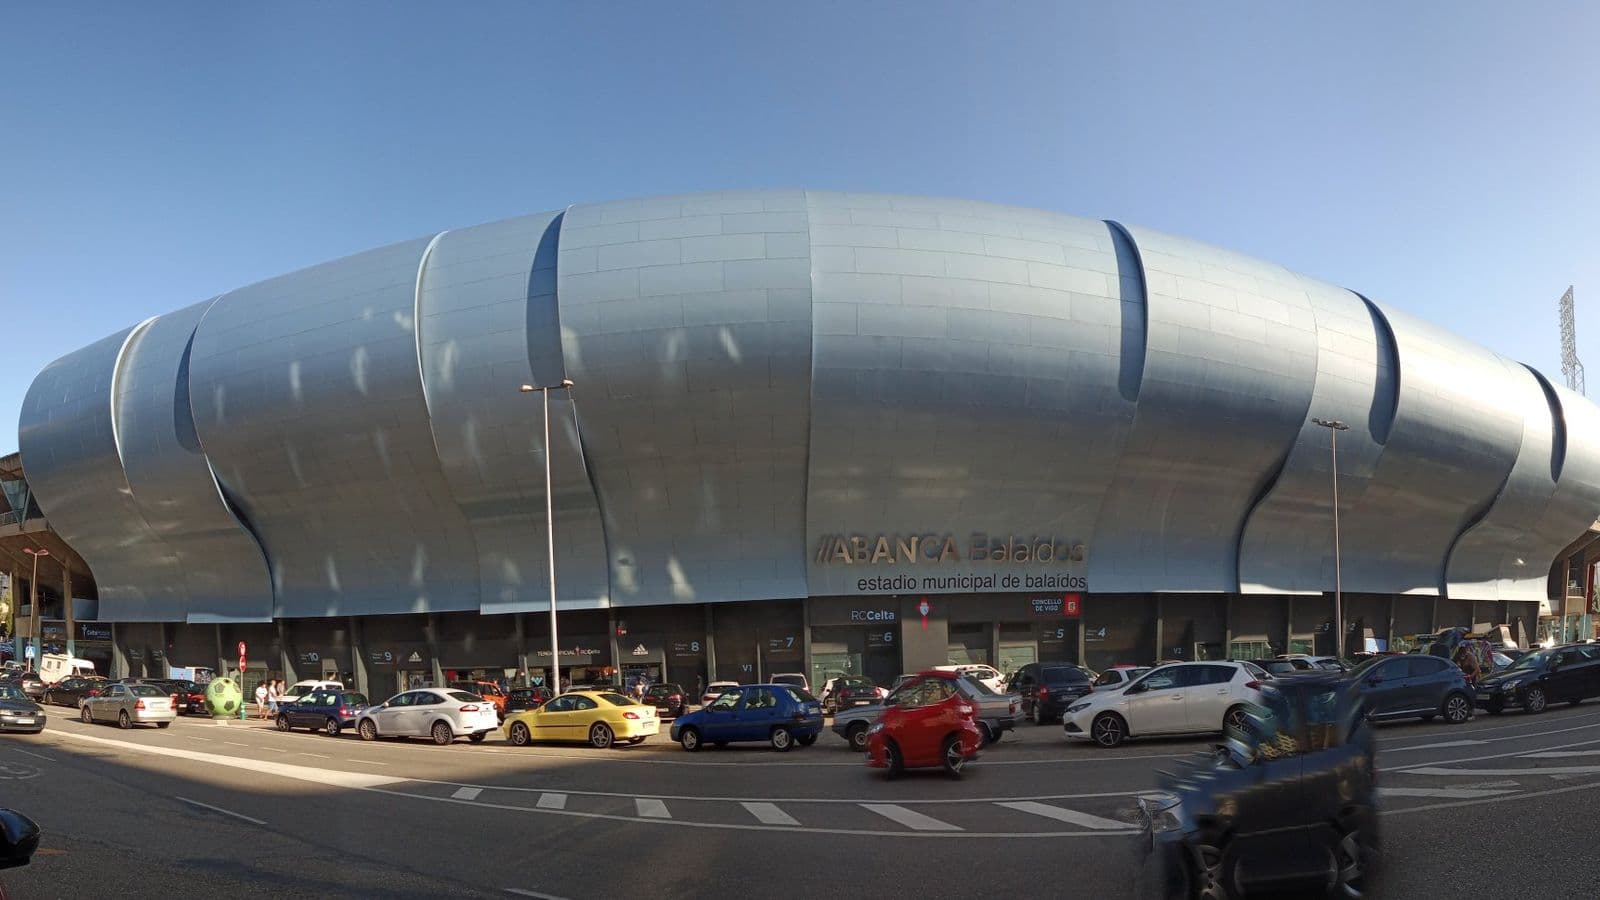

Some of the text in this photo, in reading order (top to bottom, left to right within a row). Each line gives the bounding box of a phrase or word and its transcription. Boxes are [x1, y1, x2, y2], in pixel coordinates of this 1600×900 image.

[969, 533, 1086, 564] Balaídos
[857, 573, 1087, 592] estadio municipal de balaídos
[1032, 598, 1062, 606] CONCELLO
[884, 632, 893, 642] 6
[1056, 629, 1065, 639] 5
[691, 641, 700, 652] 8
[786, 637, 795, 648] 7
[308, 652, 319, 662] 10
[384, 651, 393, 661] 9
[742, 664, 753, 672] V1
